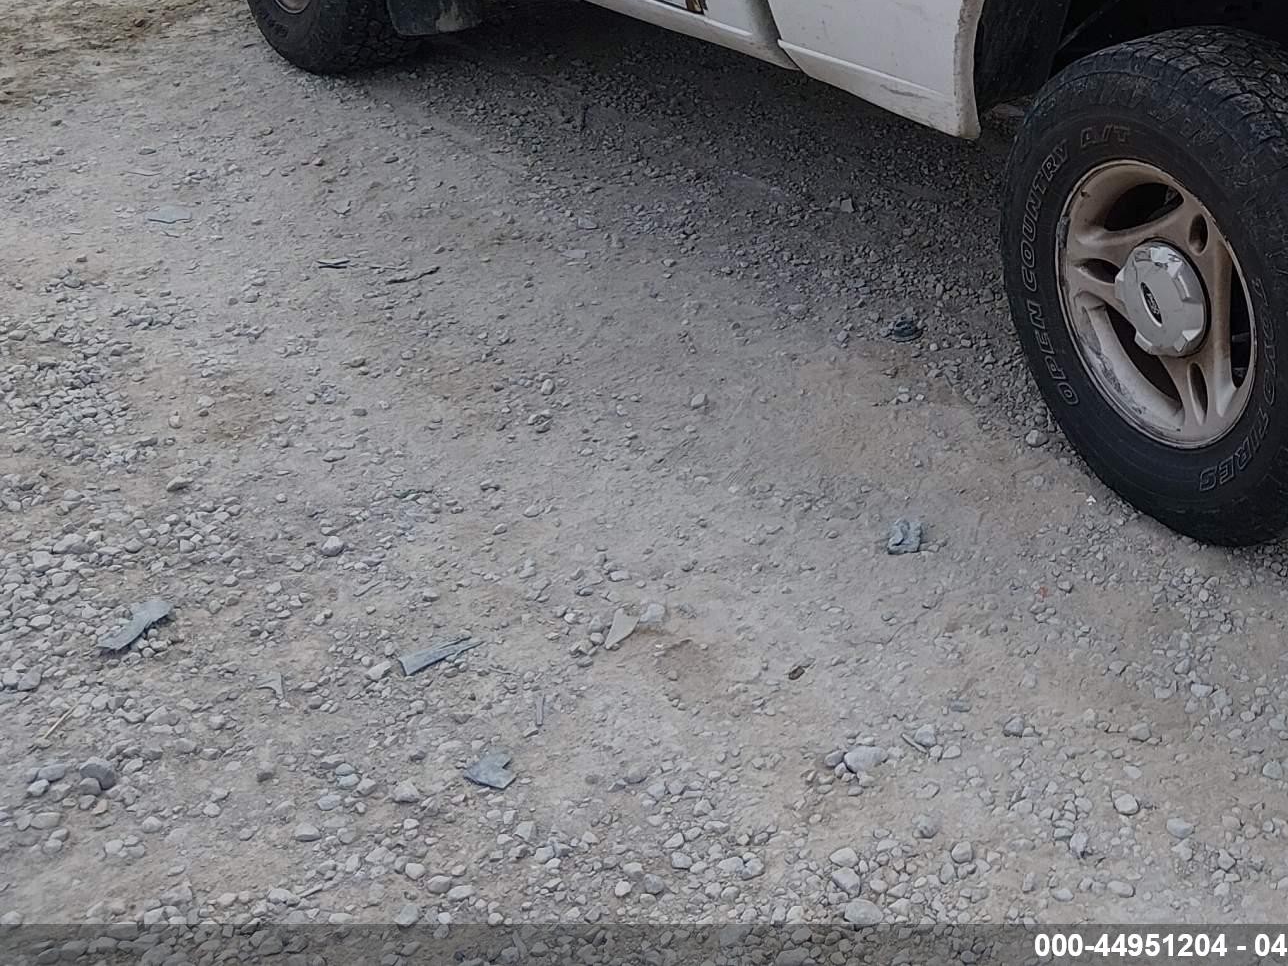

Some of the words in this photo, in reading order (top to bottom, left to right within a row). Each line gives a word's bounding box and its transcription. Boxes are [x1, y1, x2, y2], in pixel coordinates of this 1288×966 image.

[1021, 139, 1070, 292] COUNTRY
[1028, 298, 1079, 407] OPEN
[1199, 406, 1269, 492] TIRES
